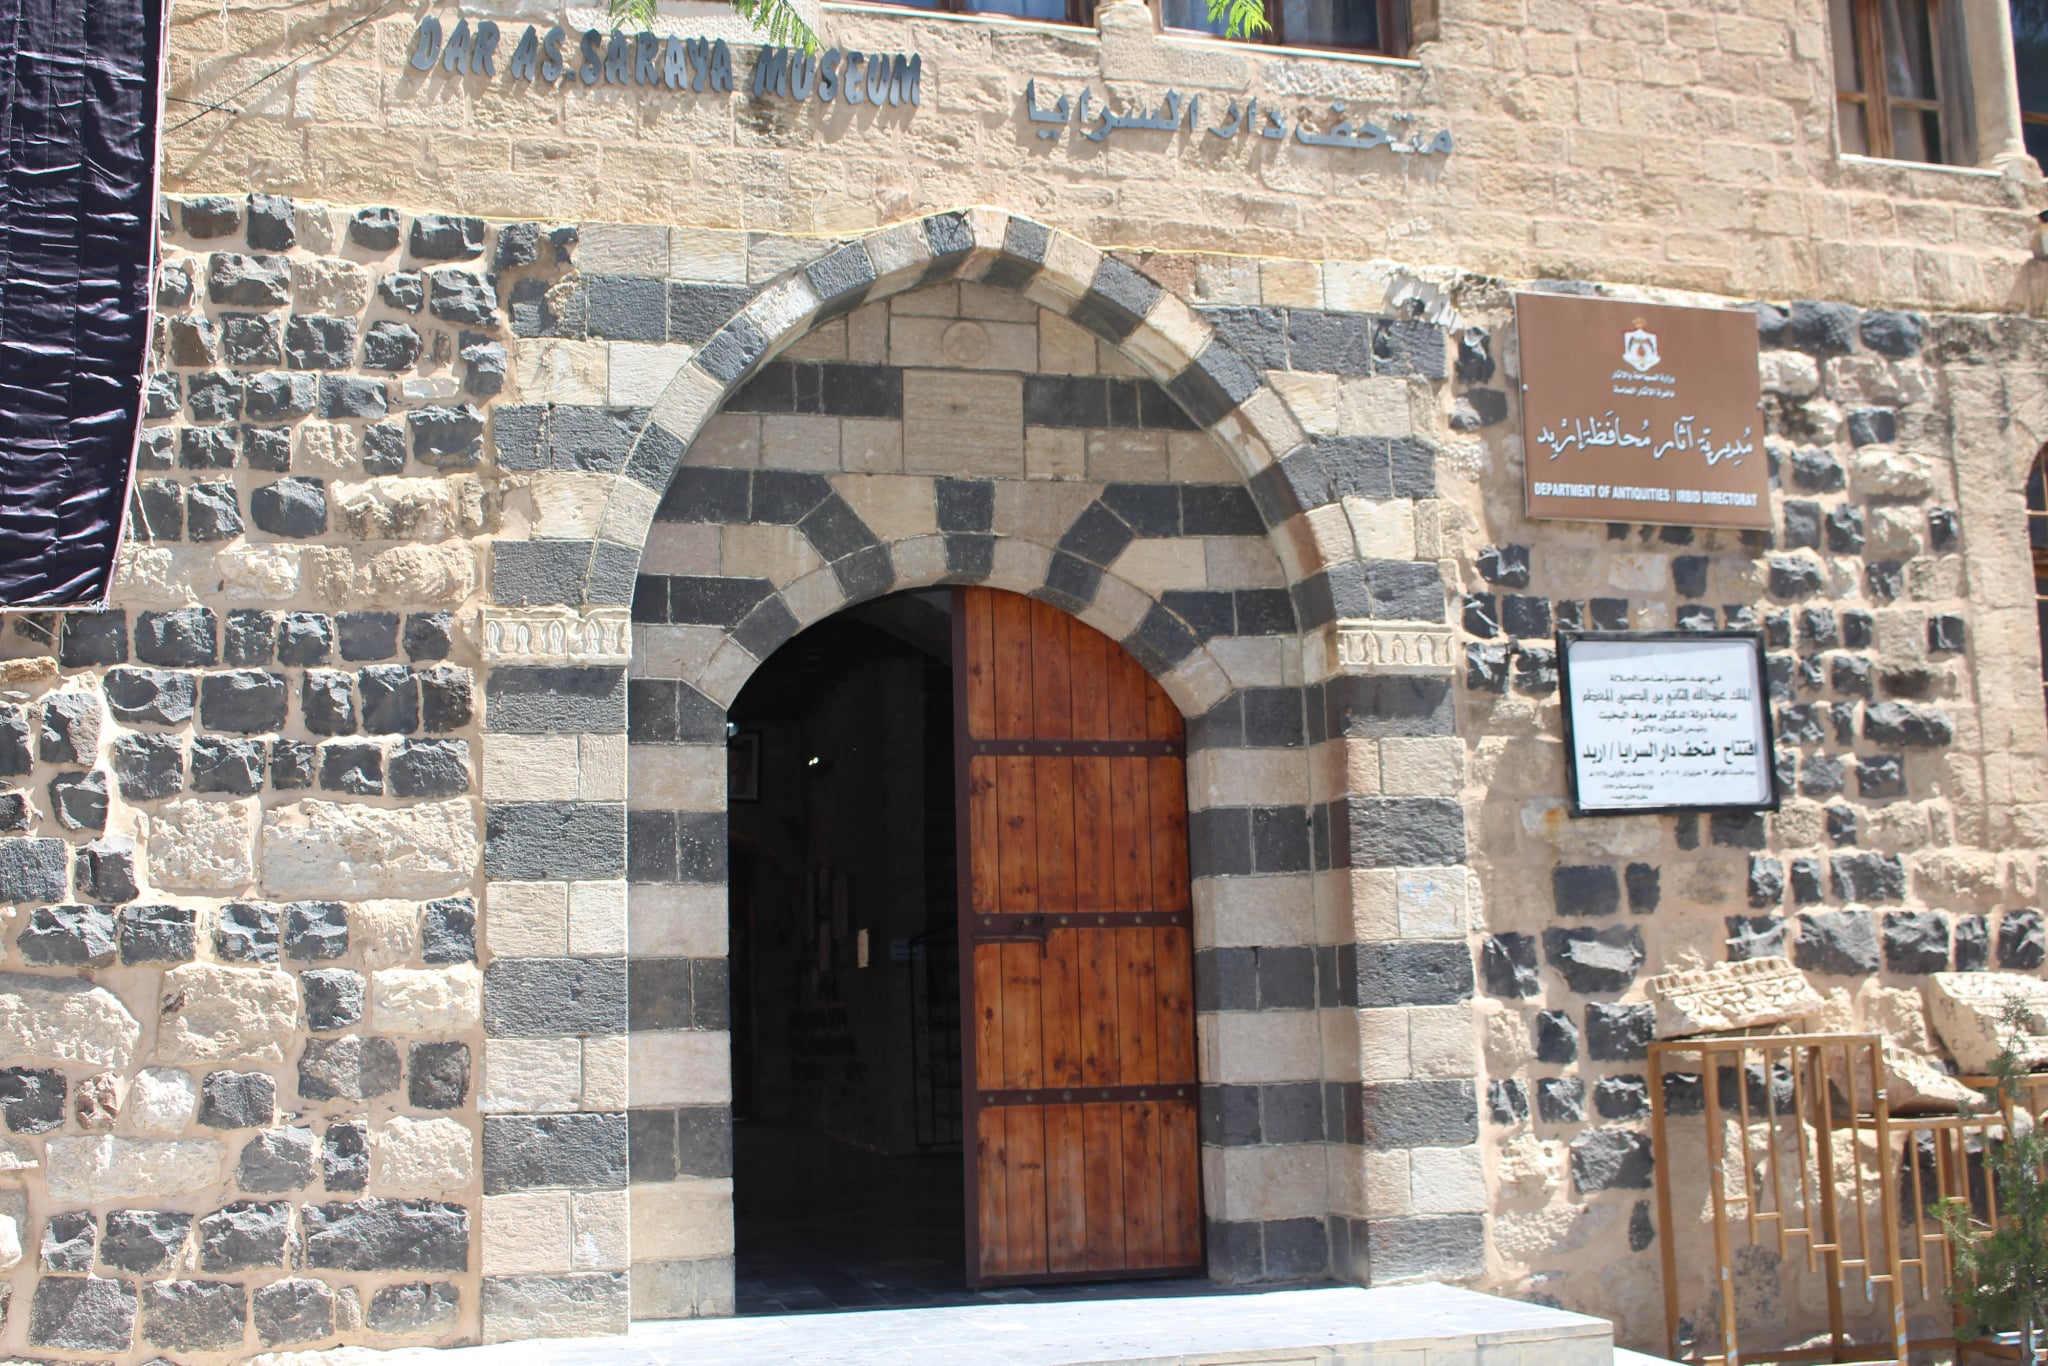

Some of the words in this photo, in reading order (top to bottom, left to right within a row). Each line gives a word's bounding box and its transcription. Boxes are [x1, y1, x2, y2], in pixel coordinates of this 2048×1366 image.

[410, 14, 501, 78] DAR
[753, 43, 923, 108] MUSEUM
[1026, 77, 1200, 142] السرايا
[1207, 96, 1287, 140] دار
[1295, 101, 1454, 156] متحف
[1534, 481, 1596, 498] DEPARTMENT
[1597, 484, 1611, 498] OF
[1612, 486, 1670, 502] ANTIQUITIES
[1676, 489, 1700, 504] IRBID
[1617, 688, 1648, 706] الحسين
[1652, 692, 1664, 704] بن
[1729, 688, 1752, 702] الملك
[1599, 710, 1629, 723] البخيت
[1631, 711, 1658, 722] معروف
[1659, 709, 1689, 721] الدكتور
[1618, 741, 1659, 764] السرايا
[1660, 742, 1677, 763] دار
[1678, 741, 1716, 757] متحف
[1724, 740, 1759, 764] افتتاح
